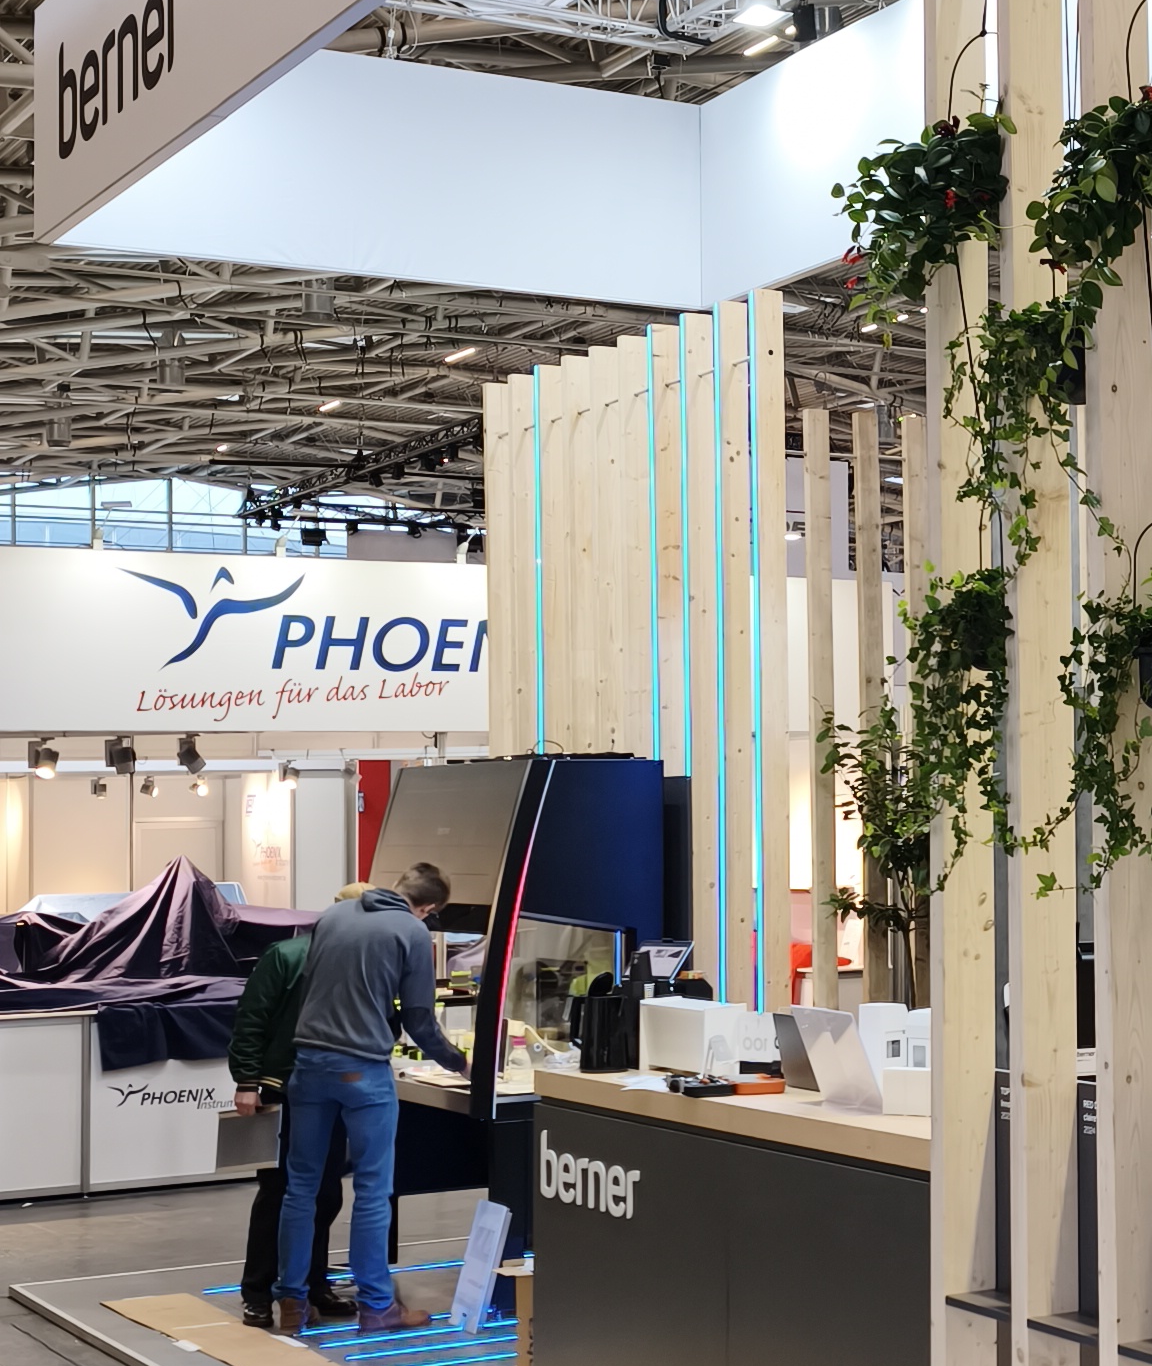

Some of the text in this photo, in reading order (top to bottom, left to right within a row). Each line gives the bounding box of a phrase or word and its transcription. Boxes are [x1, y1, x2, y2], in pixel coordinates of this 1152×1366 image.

[136, 672, 450, 723] Lösungen für das Labor
[140, 1087, 216, 1110] PHOENIX
[540, 1128, 641, 1220] berner
